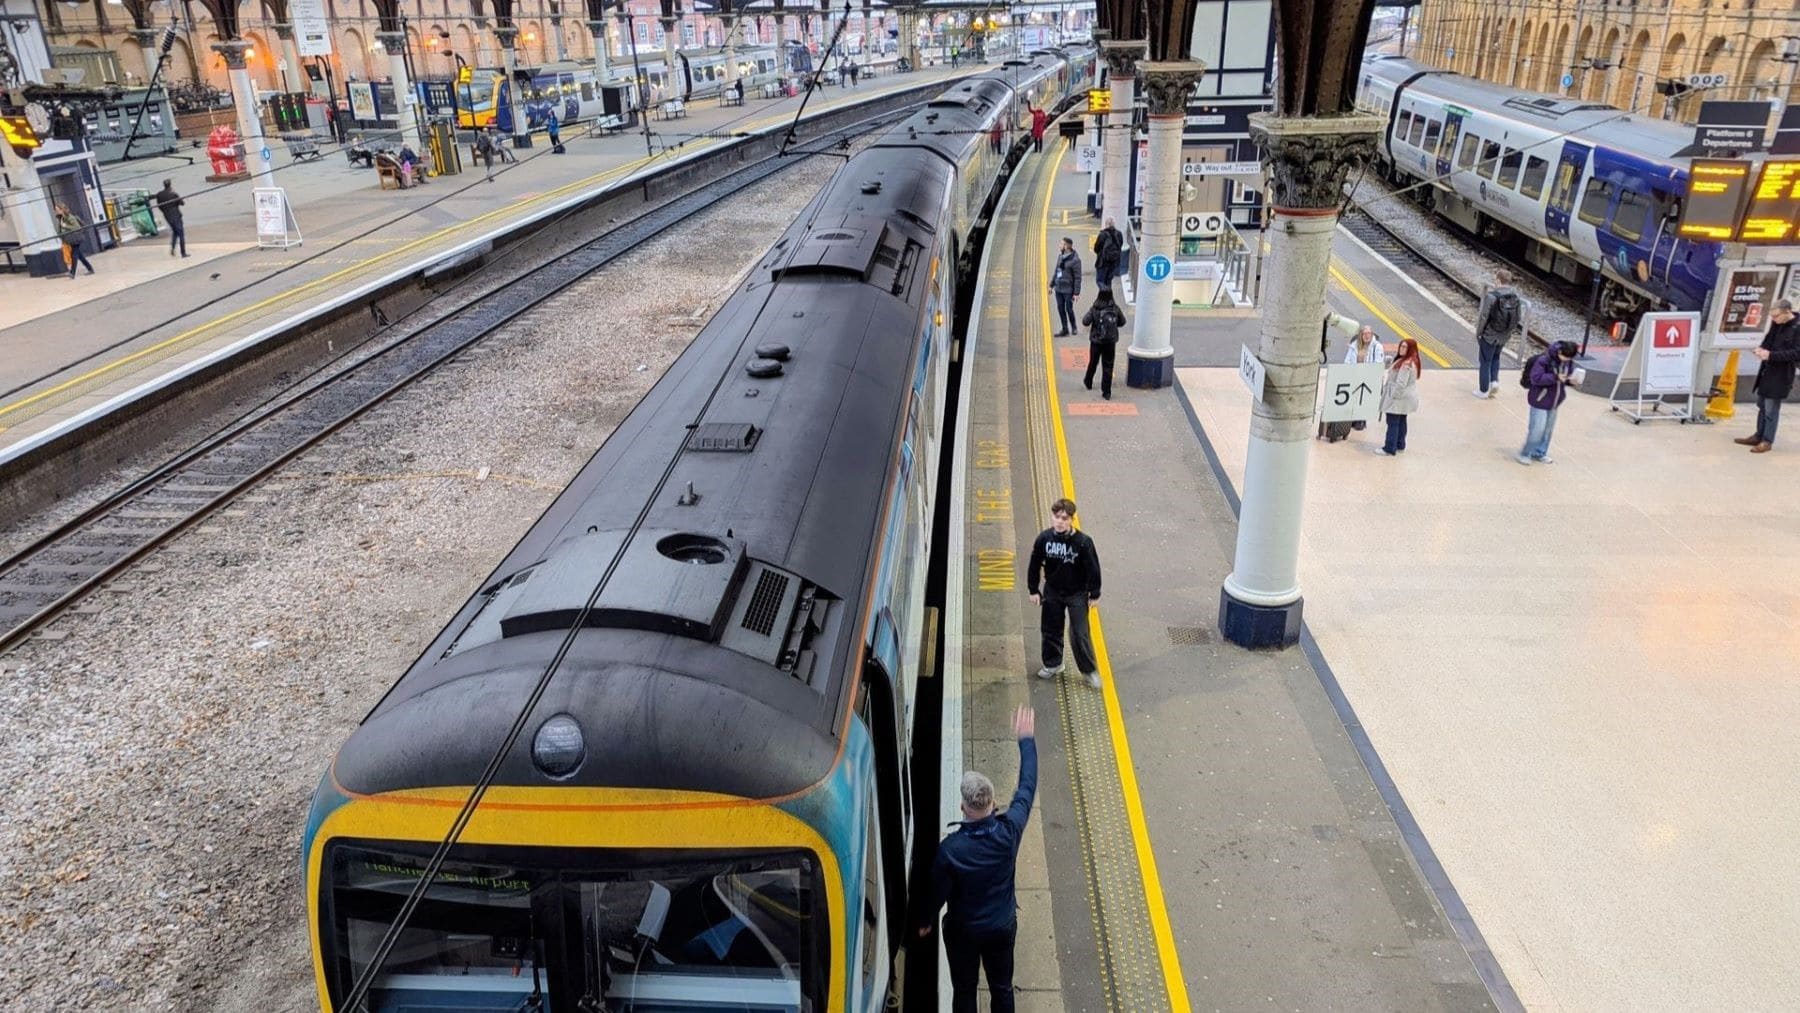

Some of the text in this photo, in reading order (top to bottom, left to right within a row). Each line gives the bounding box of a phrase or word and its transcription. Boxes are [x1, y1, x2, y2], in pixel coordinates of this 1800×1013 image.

[1706, 129, 1745, 138] Platform
[1702, 138, 1753, 148] Departures
[1083, 147, 1096, 159] 5a
[1151, 263, 1165, 276] 11
[1747, 285, 1766, 293] free
[1732, 293, 1760, 301] credit
[1243, 352, 1256, 382] York
[1334, 383, 1350, 406] 5
[976, 440, 1015, 591] MIND THE GAP
[1045, 541, 1067, 556] CAPA
